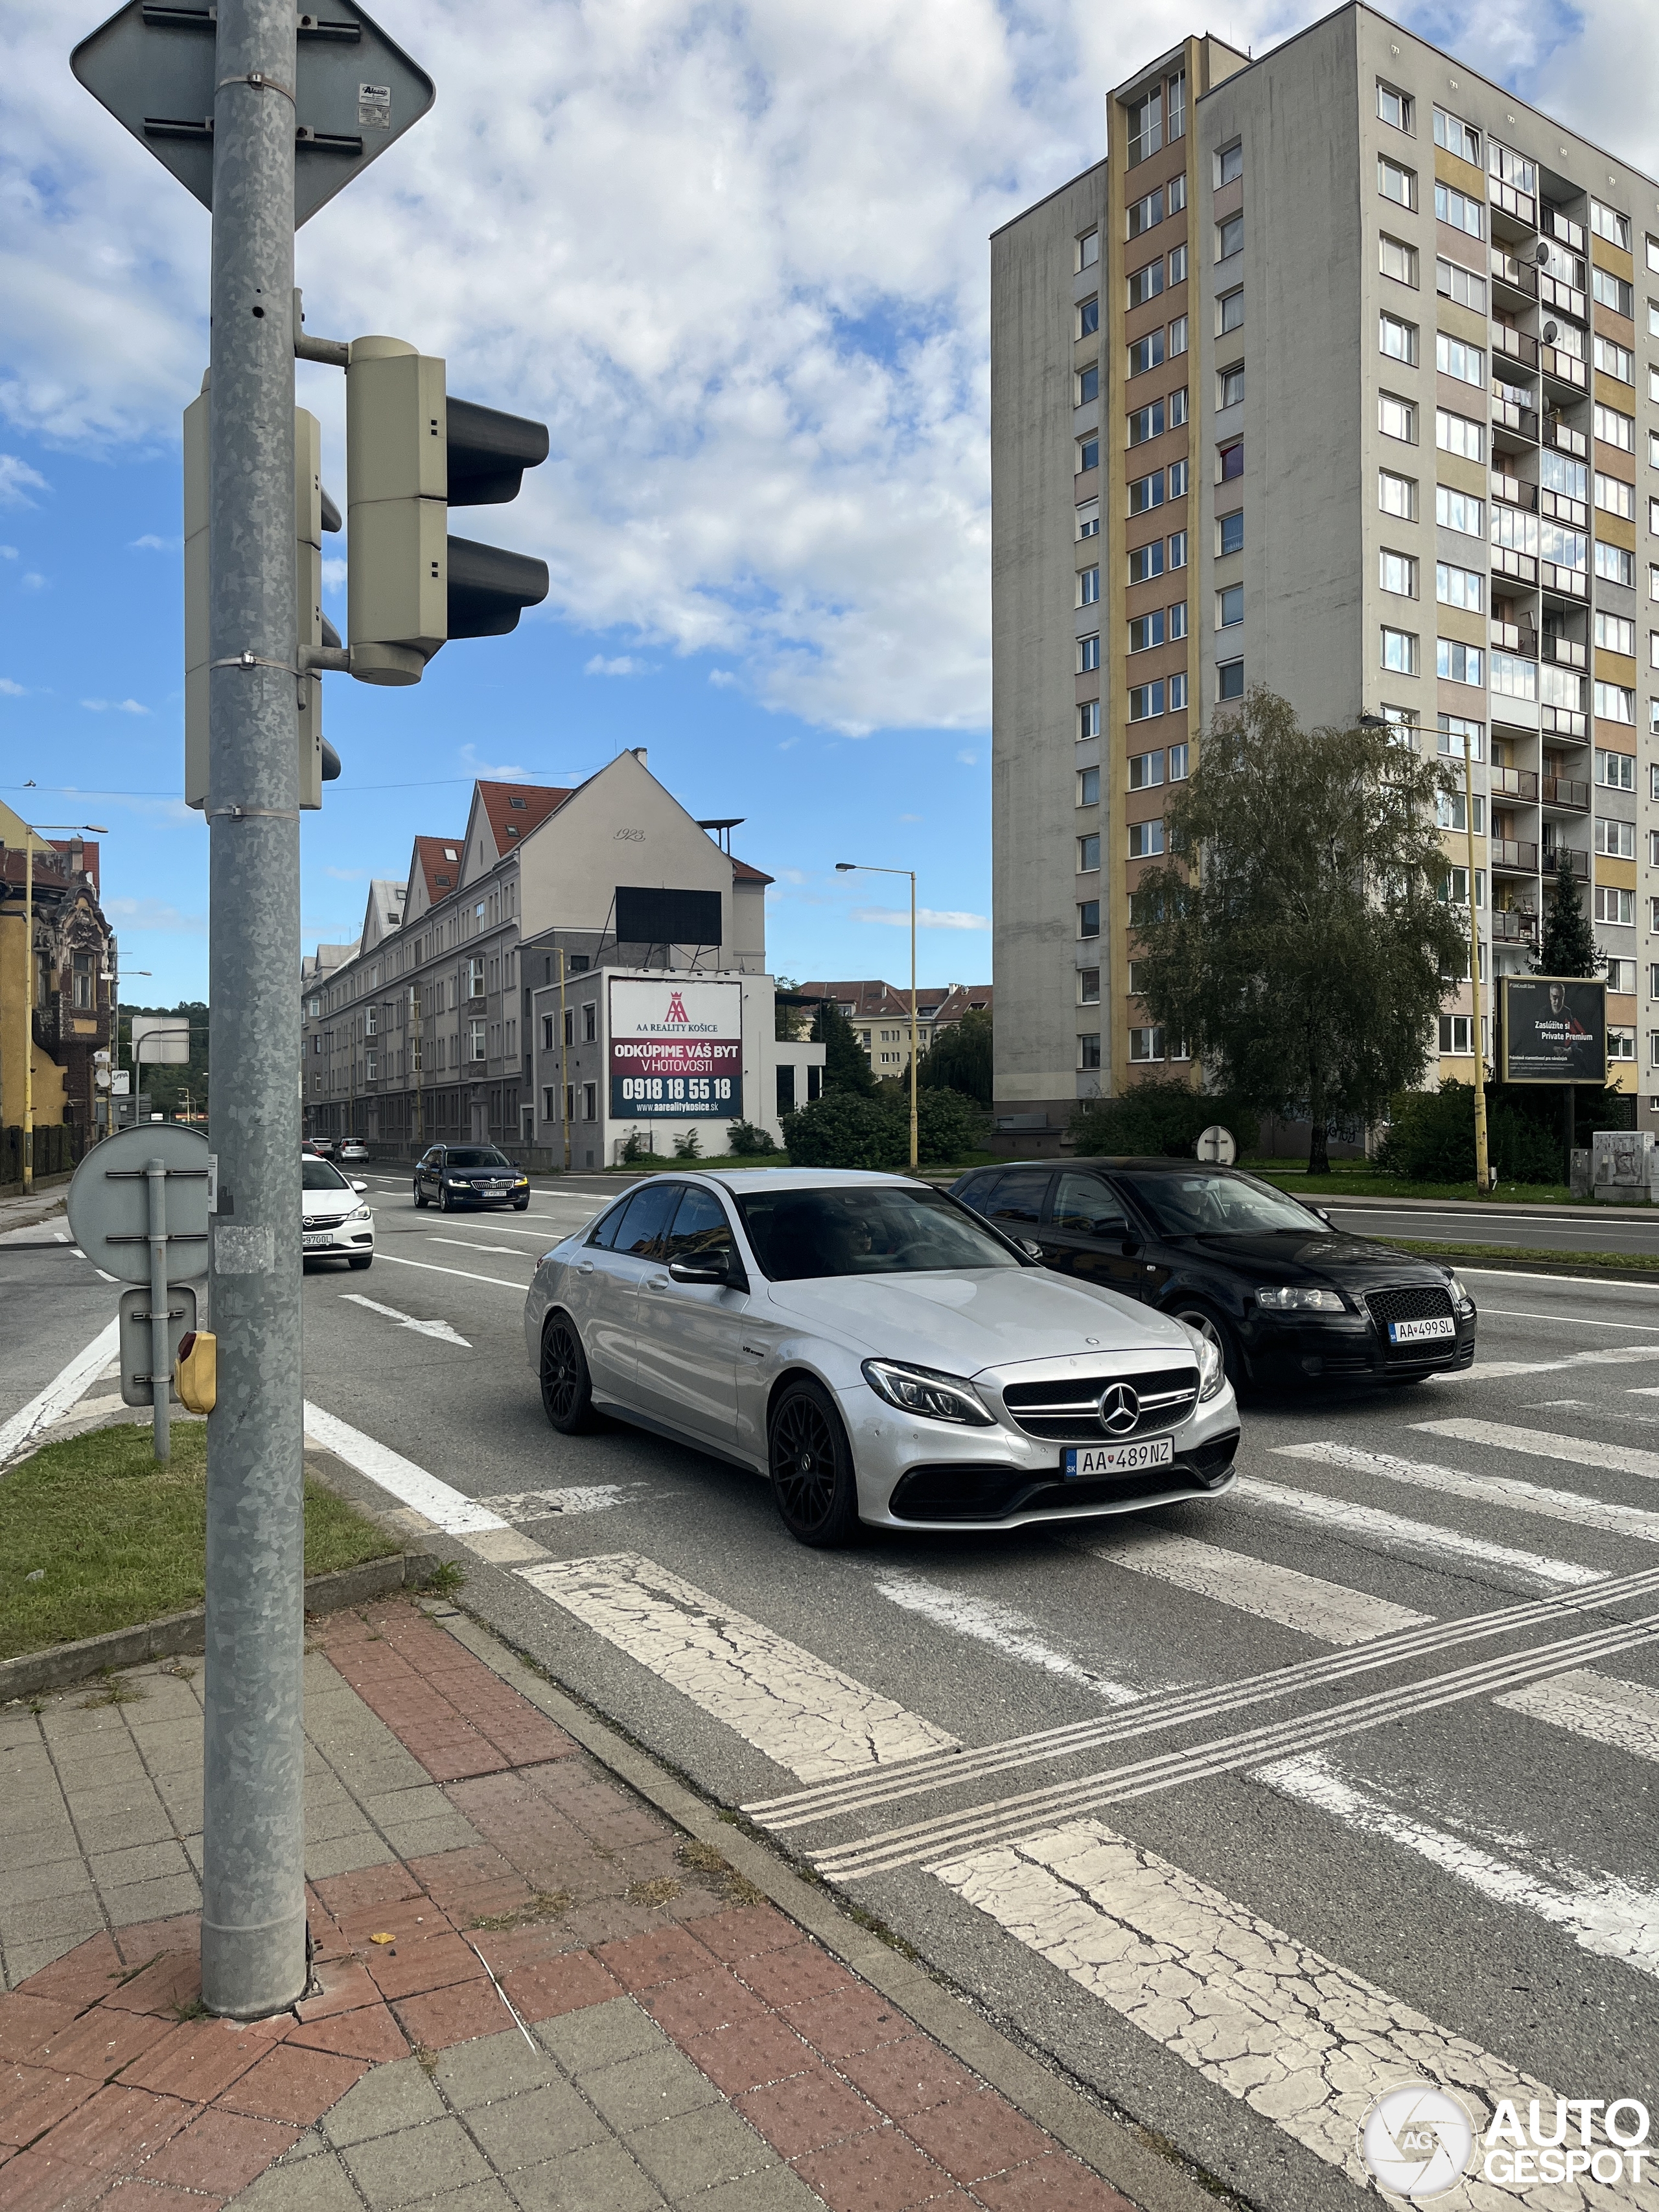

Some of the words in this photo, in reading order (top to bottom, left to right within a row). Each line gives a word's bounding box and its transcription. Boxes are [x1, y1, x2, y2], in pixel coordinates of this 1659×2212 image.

[613, 828, 645, 842] 1923
[688, 1023, 718, 1032] KOŠICE
[1535, 1020, 1563, 1030] Zaslúžite
[1541, 1032, 1564, 1040] Private
[1566, 1032, 1593, 1041] Premium
[614, 1042, 684, 1058] ODKÚPIME
[686, 1043, 712, 1058] VÁŠ
[714, 1046, 738, 1058] BYT
[642, 1060, 651, 1071] V
[652, 1060, 713, 1071] HOTOVOSTI
[623, 1078, 662, 1099] 0918
[667, 1078, 684, 1099] 18
[689, 1078, 709, 1099] 55
[713, 1078, 731, 1099] 18
[636, 1102, 719, 1112] www.aarealitykosice.sk
[1400, 1325, 1414, 1338] AA
[1419, 1320, 1452, 1335] 499SL
[1082, 1450, 1107, 1472] AA
[1116, 1441, 1169, 1468] 489NZ
